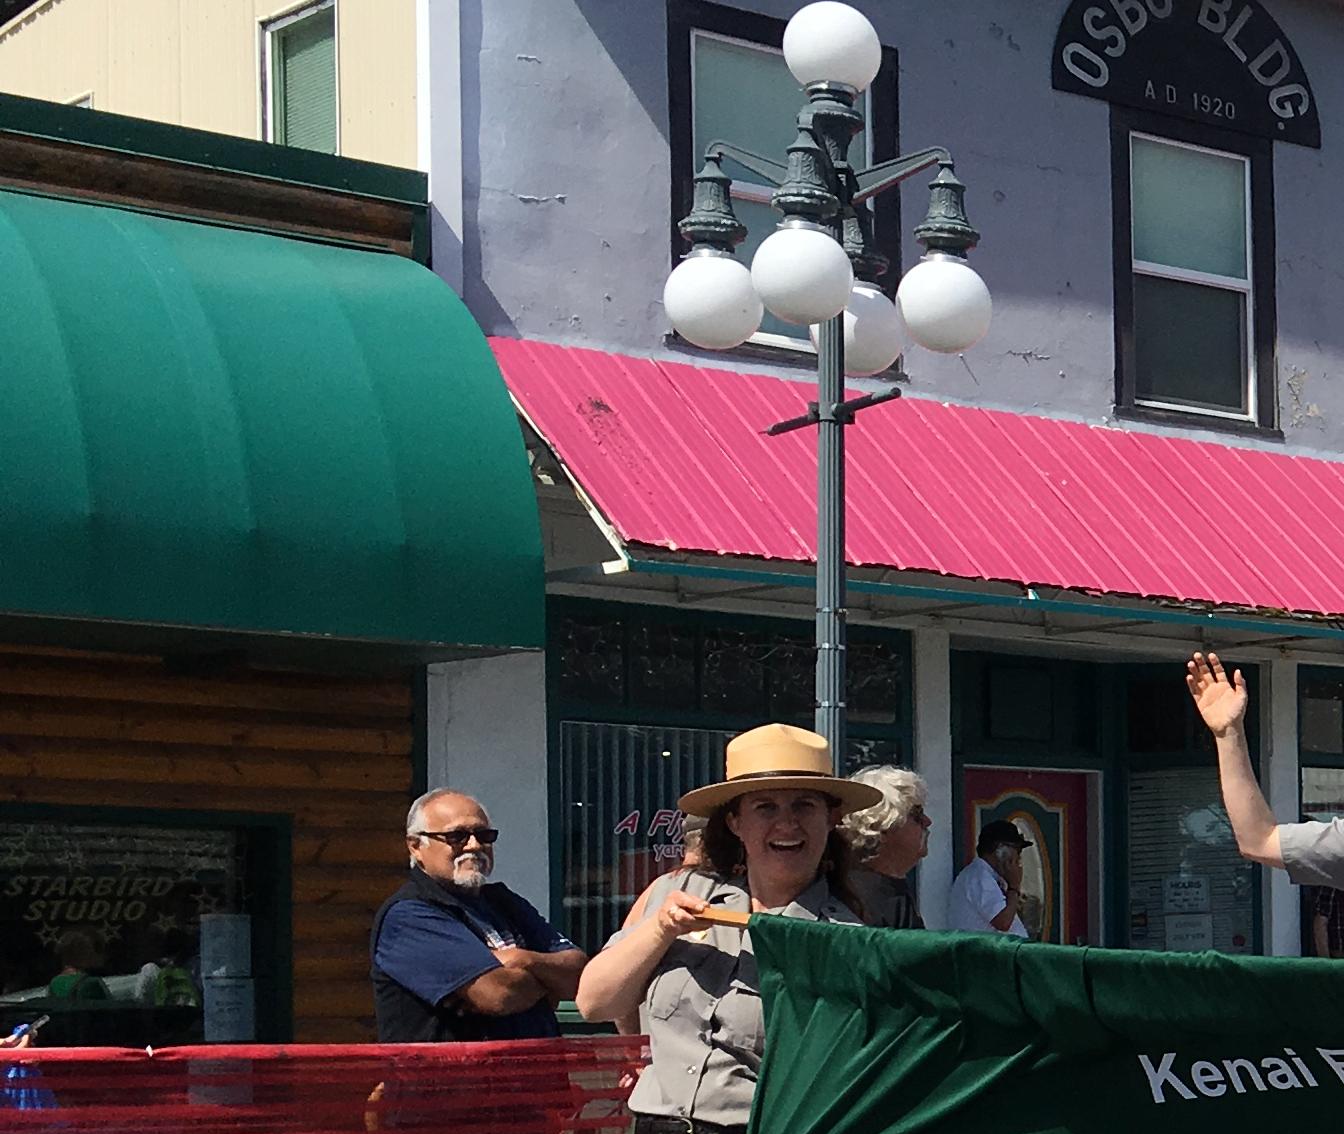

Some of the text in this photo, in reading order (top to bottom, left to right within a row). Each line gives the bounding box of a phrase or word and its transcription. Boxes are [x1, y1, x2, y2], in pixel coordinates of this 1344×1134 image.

[1191, 93, 1236, 119] 1920
[614, 810, 640, 836] A
[4, 875, 174, 896] STARBIRD
[23, 899, 146, 921] STUDIO
[1137, 1047, 1319, 1104] Kenai
